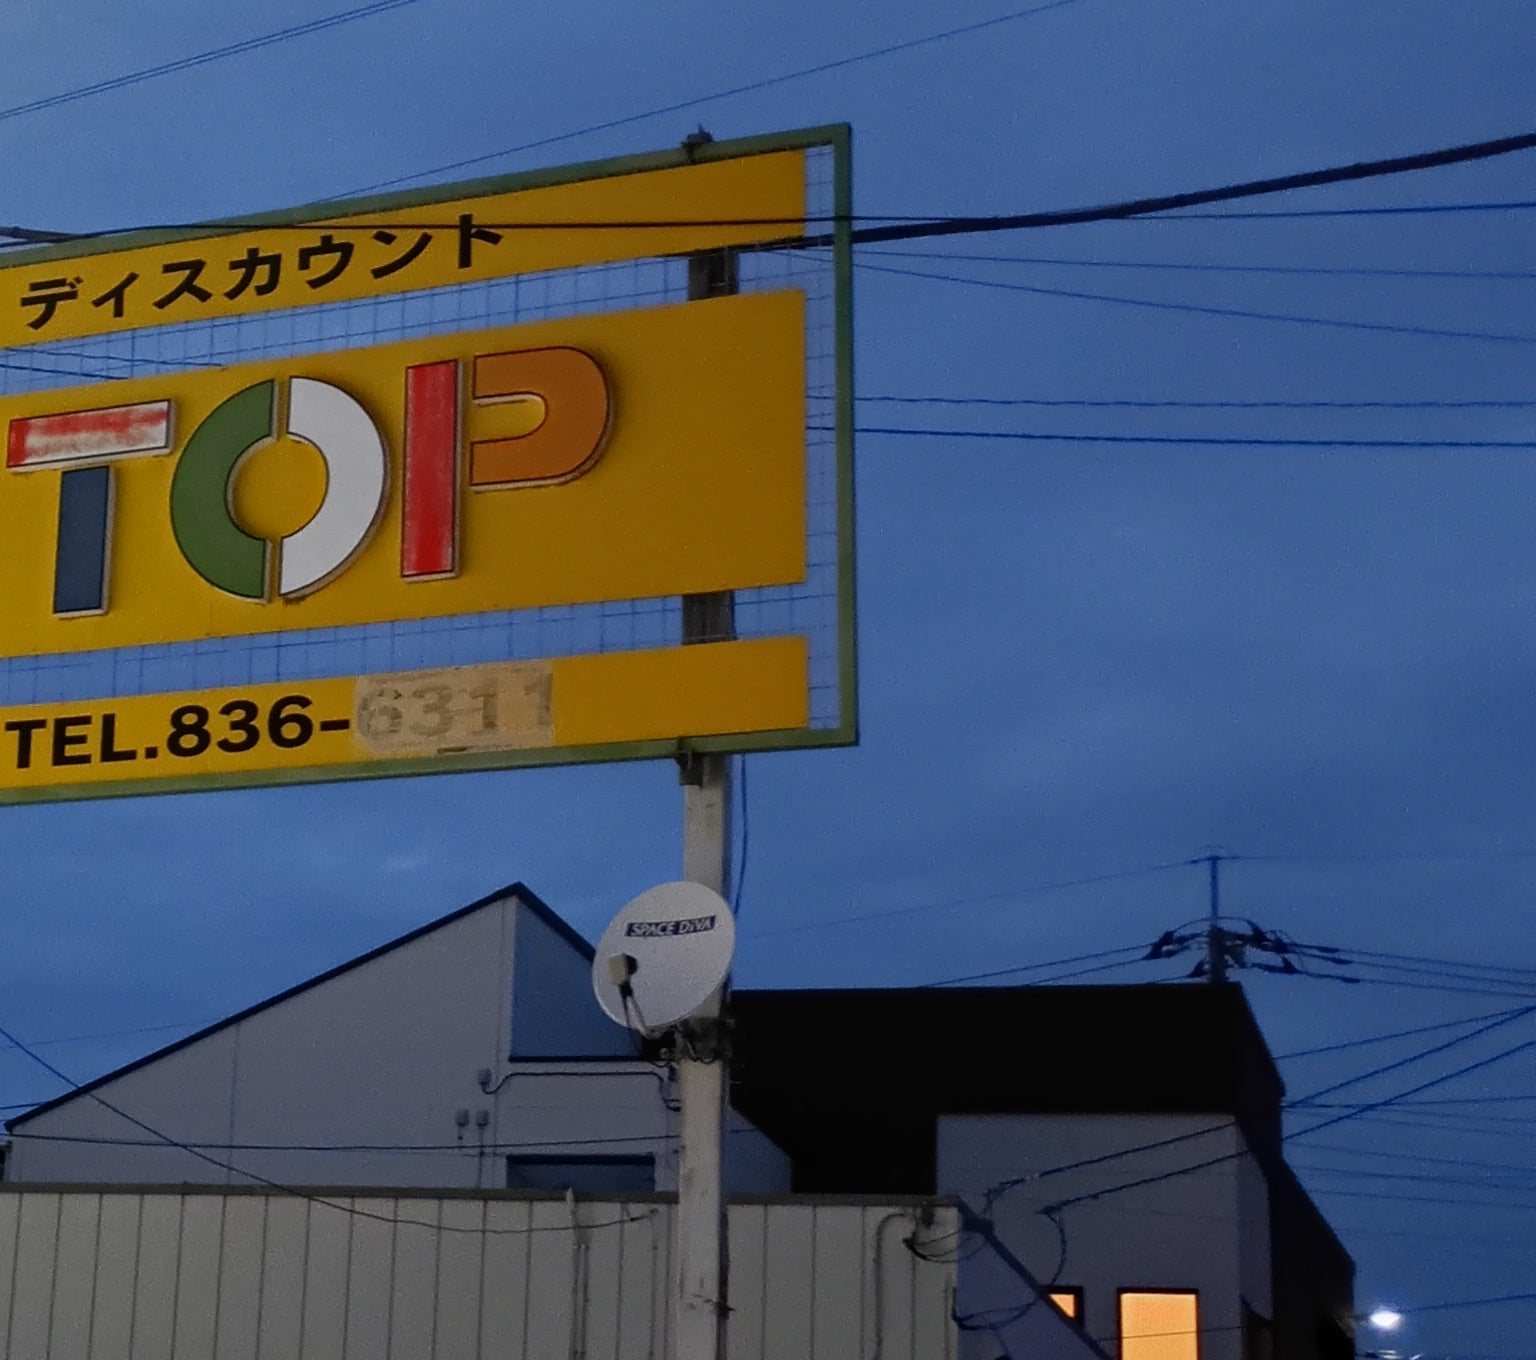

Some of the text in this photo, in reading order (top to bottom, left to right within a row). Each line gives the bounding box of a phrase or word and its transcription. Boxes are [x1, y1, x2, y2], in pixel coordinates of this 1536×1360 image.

[20, 213, 504, 330] ディスカウント
[630, 922, 676, 936] SPACE
